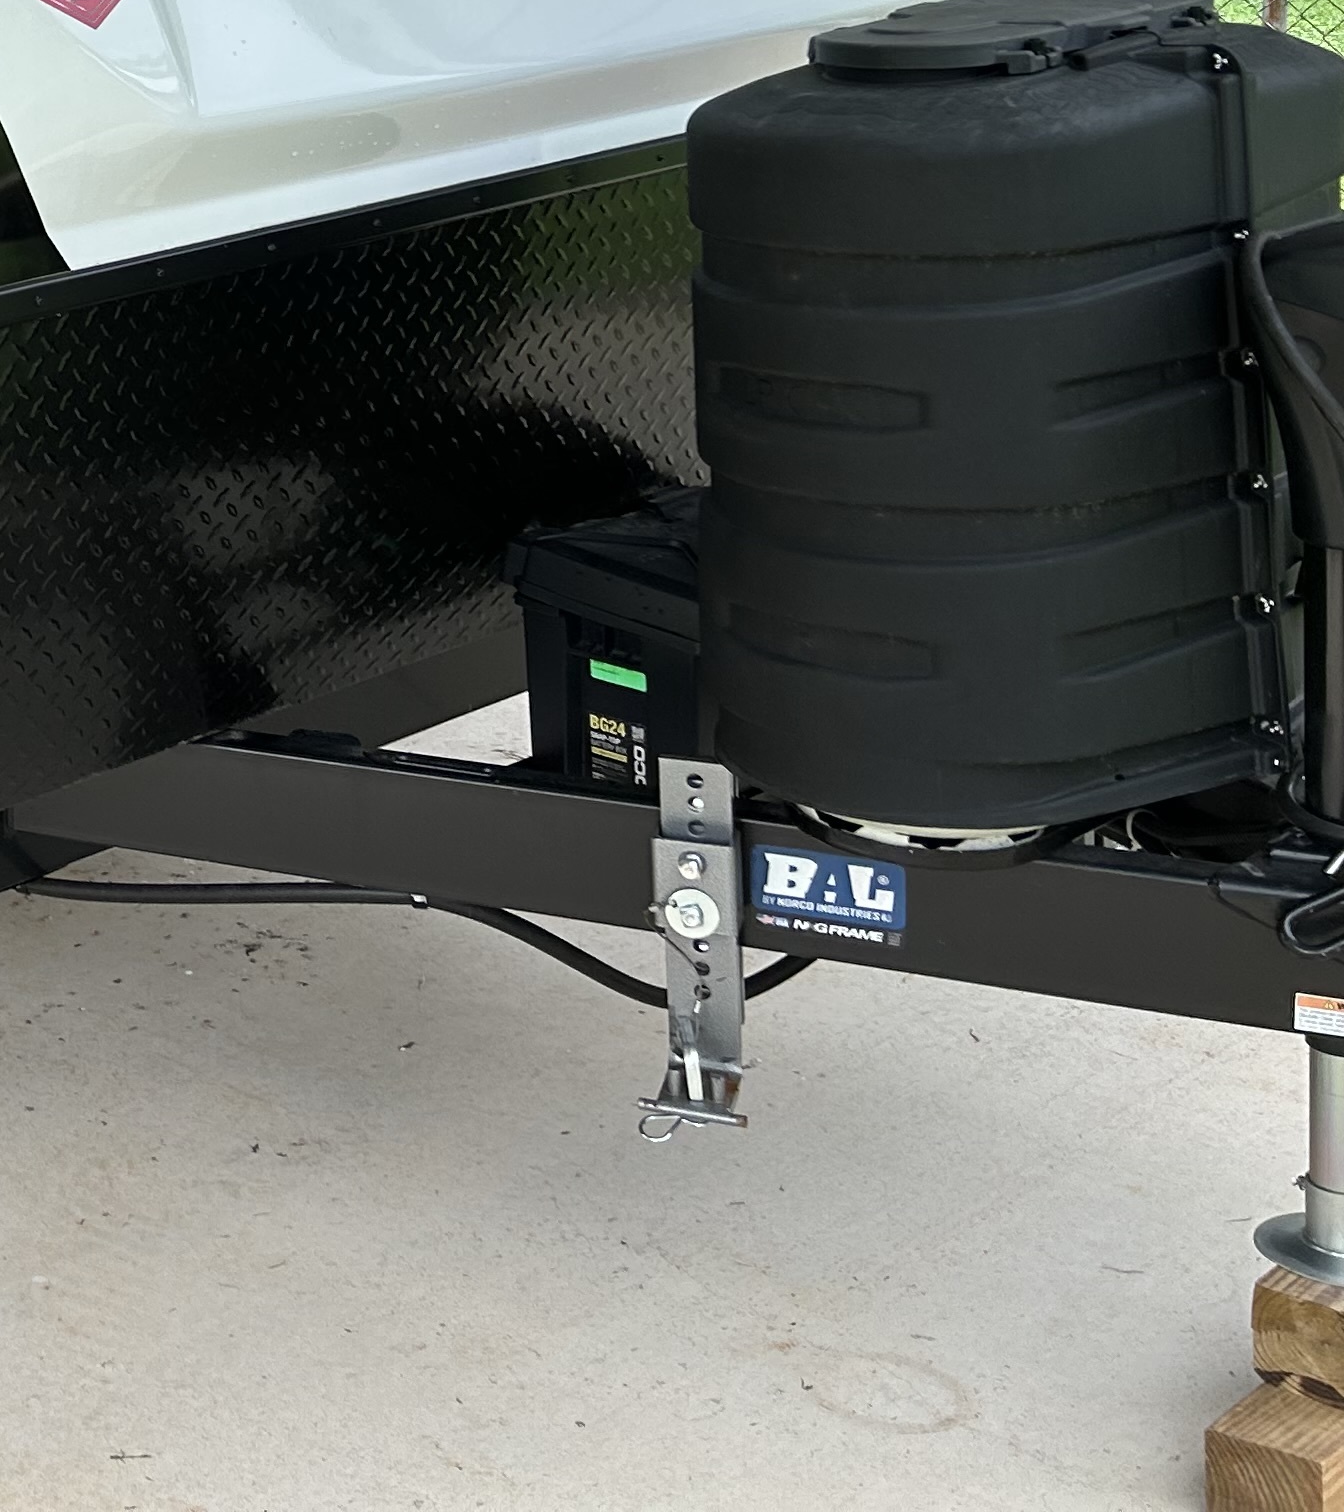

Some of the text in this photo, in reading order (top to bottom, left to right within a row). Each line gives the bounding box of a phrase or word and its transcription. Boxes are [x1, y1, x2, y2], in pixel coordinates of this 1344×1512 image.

[589, 713, 627, 738] BG24
[776, 897, 815, 912] NORCO
[815, 903, 881, 921] INDUSTRIES
